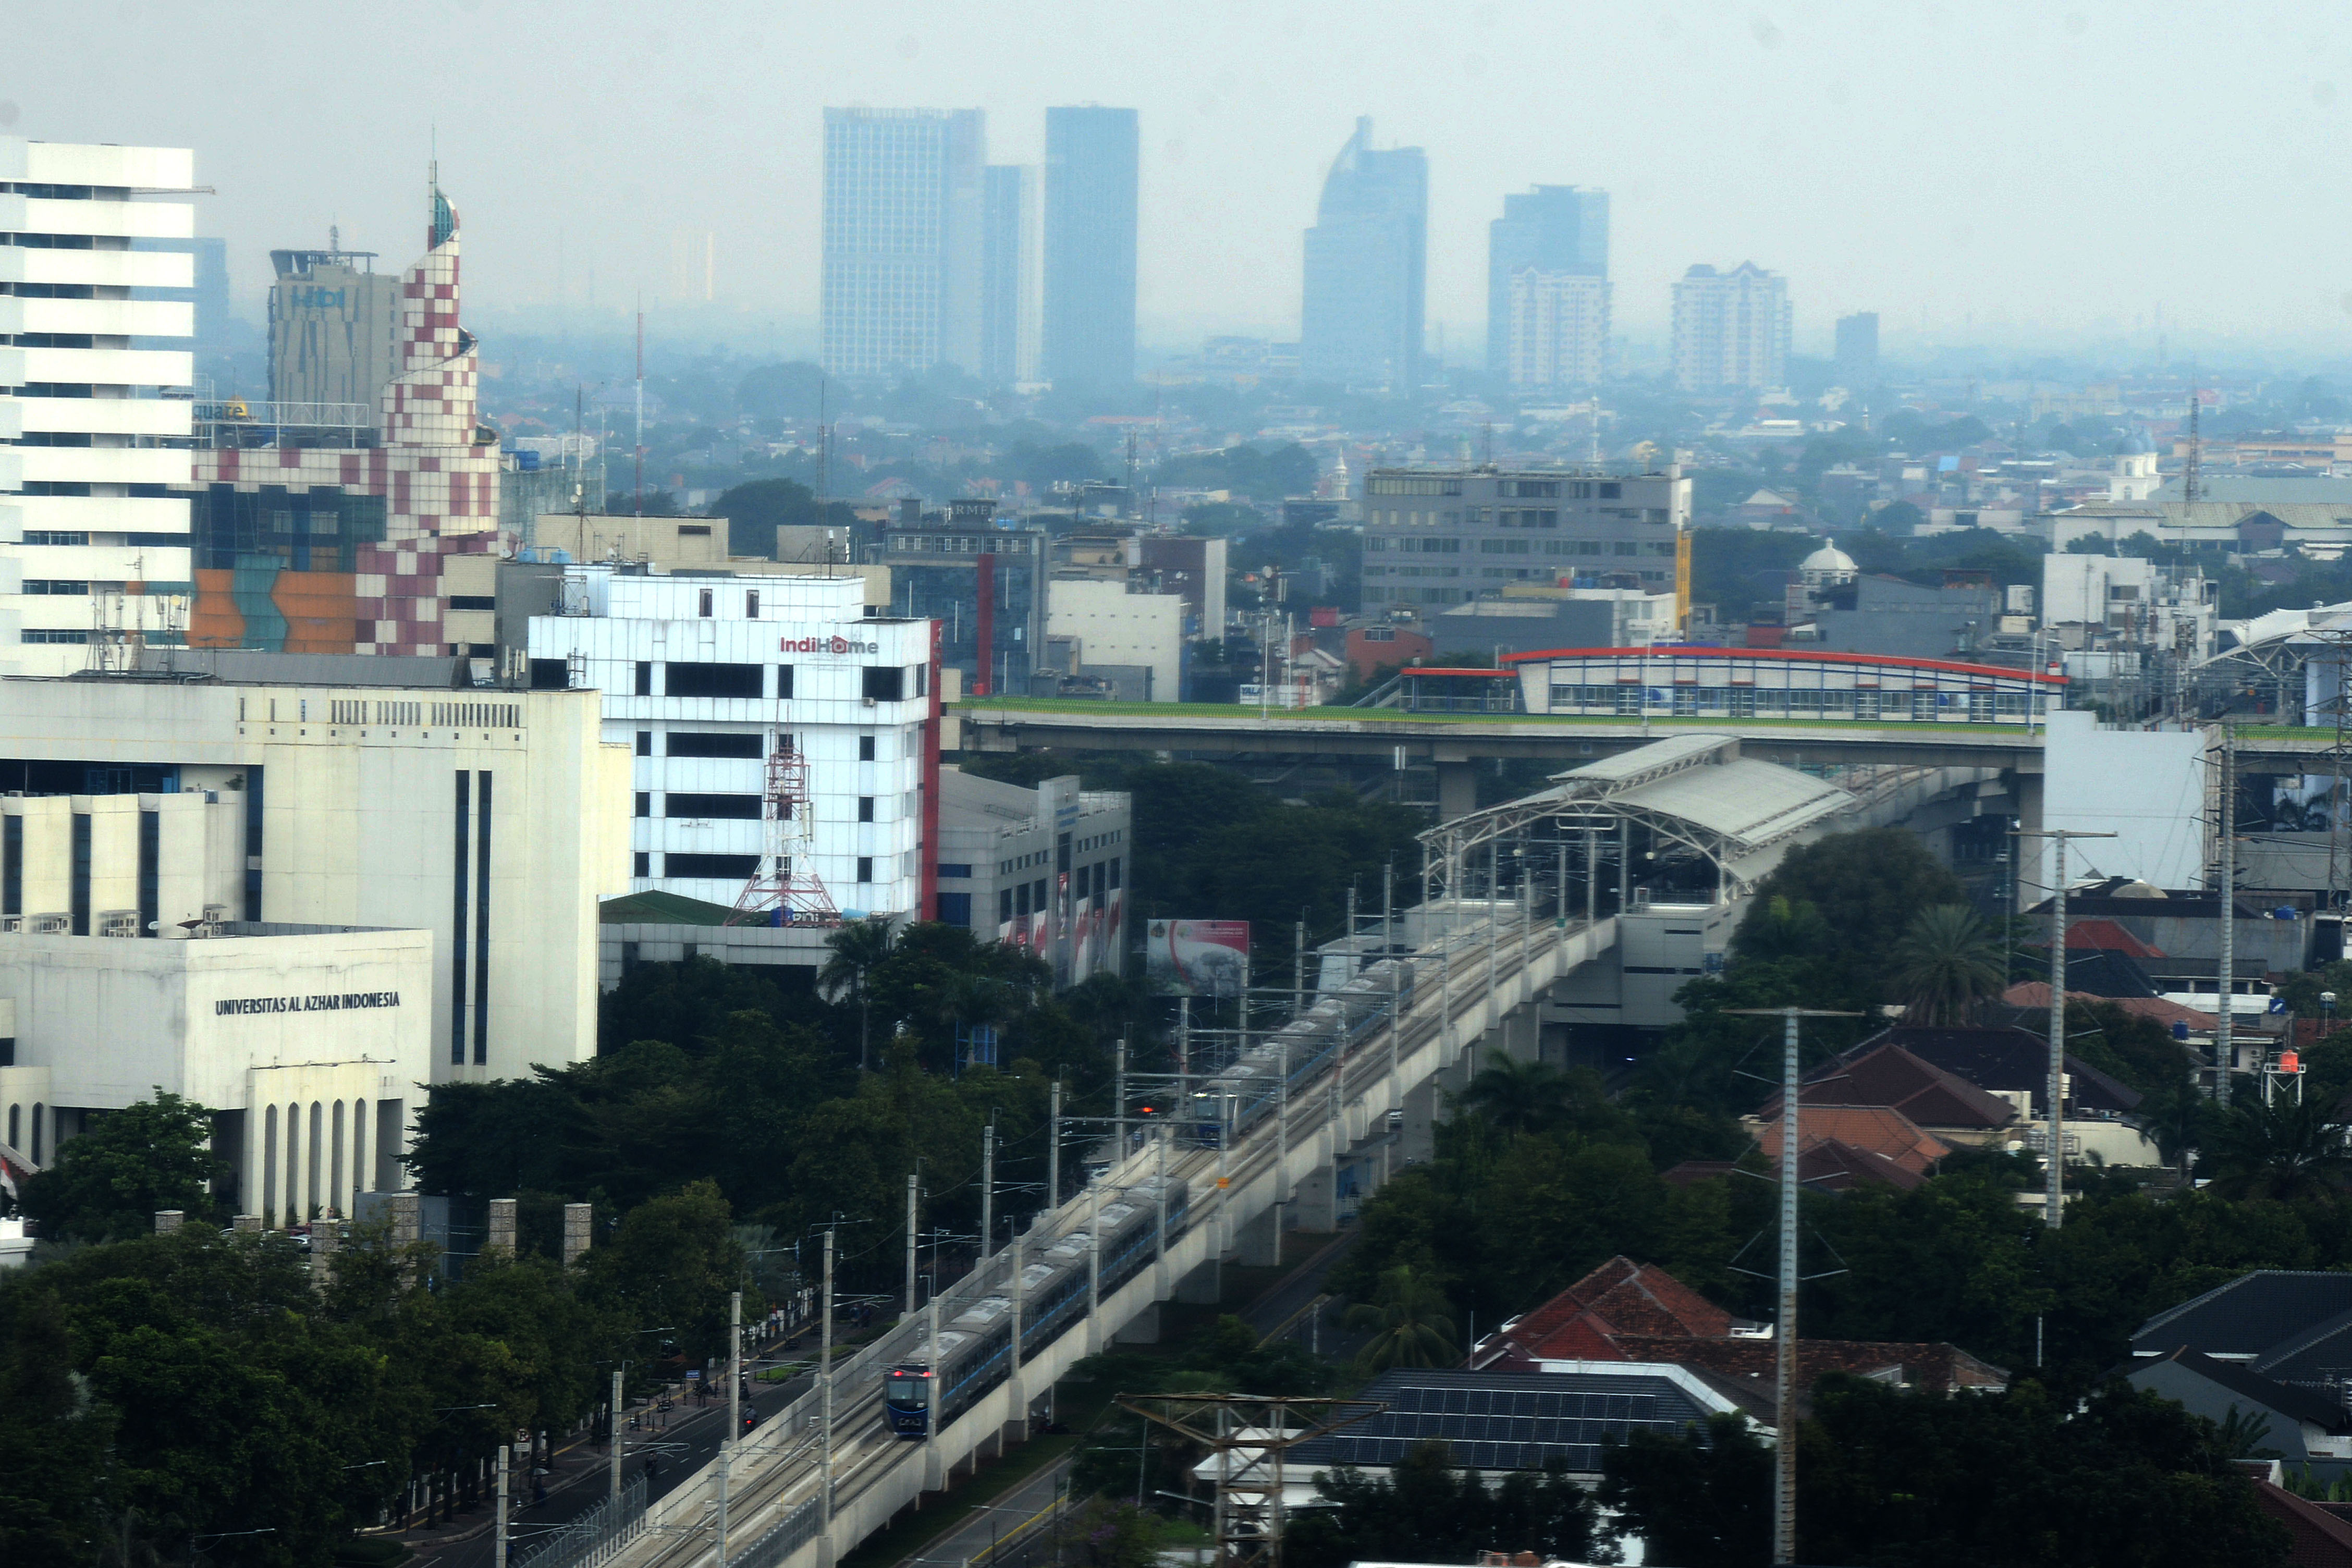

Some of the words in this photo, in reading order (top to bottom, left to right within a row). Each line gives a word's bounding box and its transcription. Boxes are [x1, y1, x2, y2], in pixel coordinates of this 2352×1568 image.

[192, 405, 244, 421] quare
[780, 635, 879, 654] IndiHome
[215, 997, 286, 1016] UNIVERSITAS
[288, 996, 301, 1012] AL
[304, 994, 340, 1011] AZHAR
[342, 991, 400, 1009] INDONESIA
